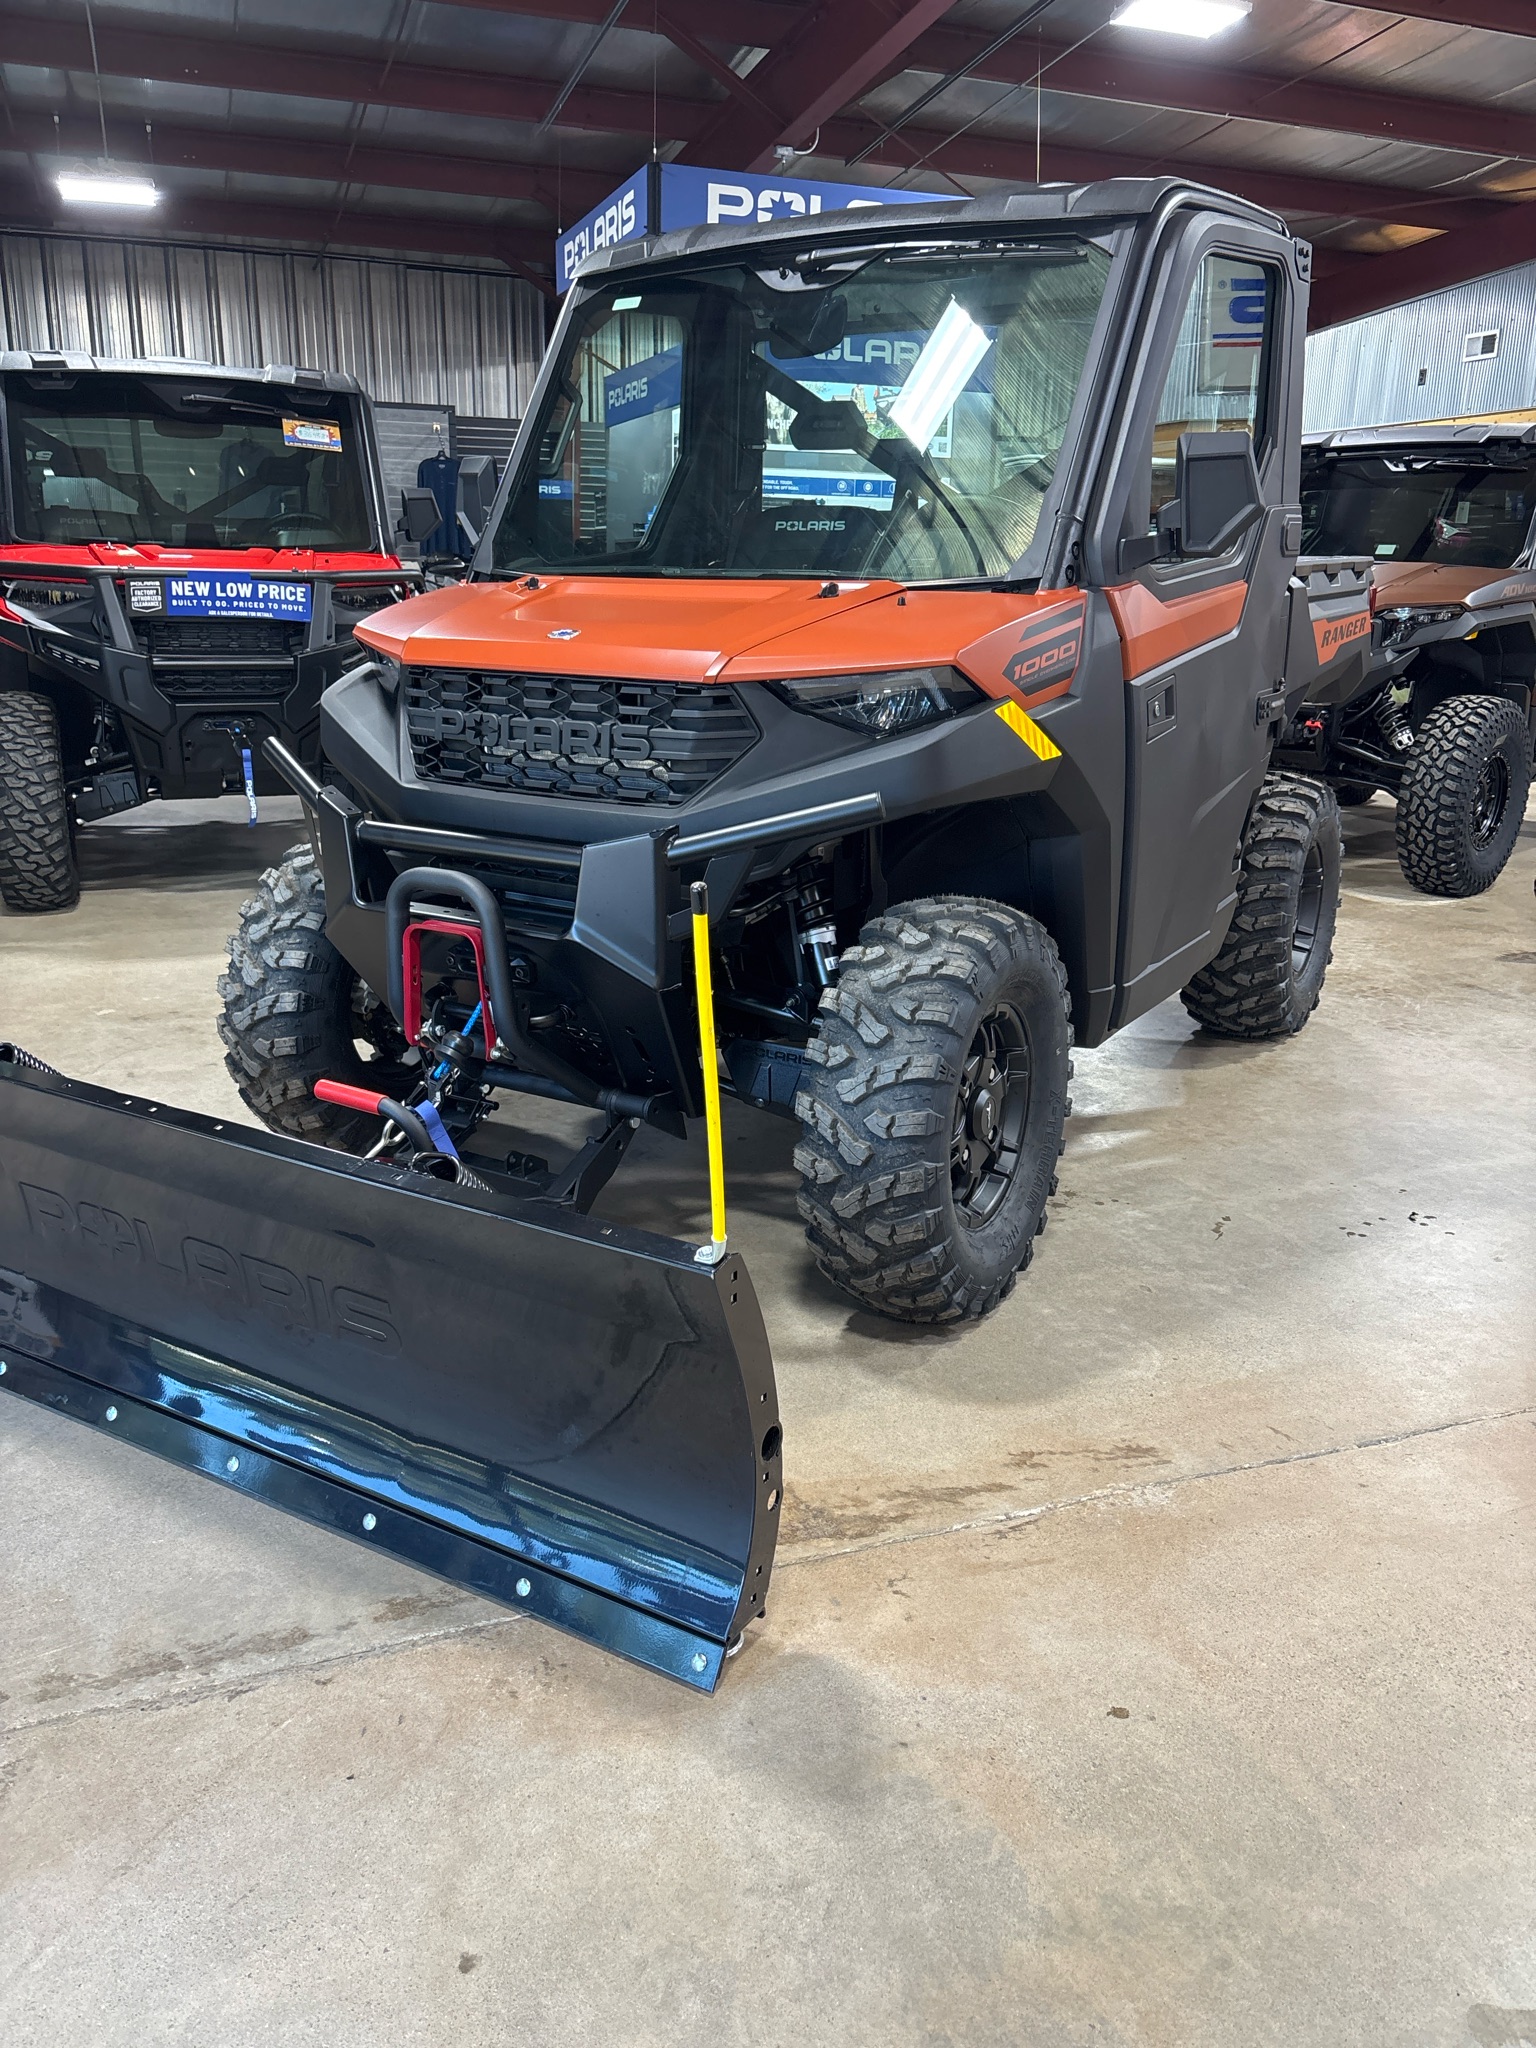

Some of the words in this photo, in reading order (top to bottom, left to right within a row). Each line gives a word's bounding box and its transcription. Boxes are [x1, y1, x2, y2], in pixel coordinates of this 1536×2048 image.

[563, 188, 635, 279] POLARIS
[608, 376, 648, 410] POLARIS
[539, 485, 561, 495] RIS
[774, 520, 846, 531] POLARIS
[171, 581, 210, 597] NEW
[215, 582, 253, 598] LOW
[258, 583, 306, 602] PRICE
[215, 600, 230, 608] GO.
[233, 601, 265, 609] PRICED
[282, 604, 307, 613] MOVE.
[1321, 616, 1367, 648] RANGER
[1013, 640, 1076, 681] 1000
[435, 708, 651, 761] POLARIS
[245, 780, 258, 819] POLARIS
[19, 1181, 403, 1361] POLARIS
